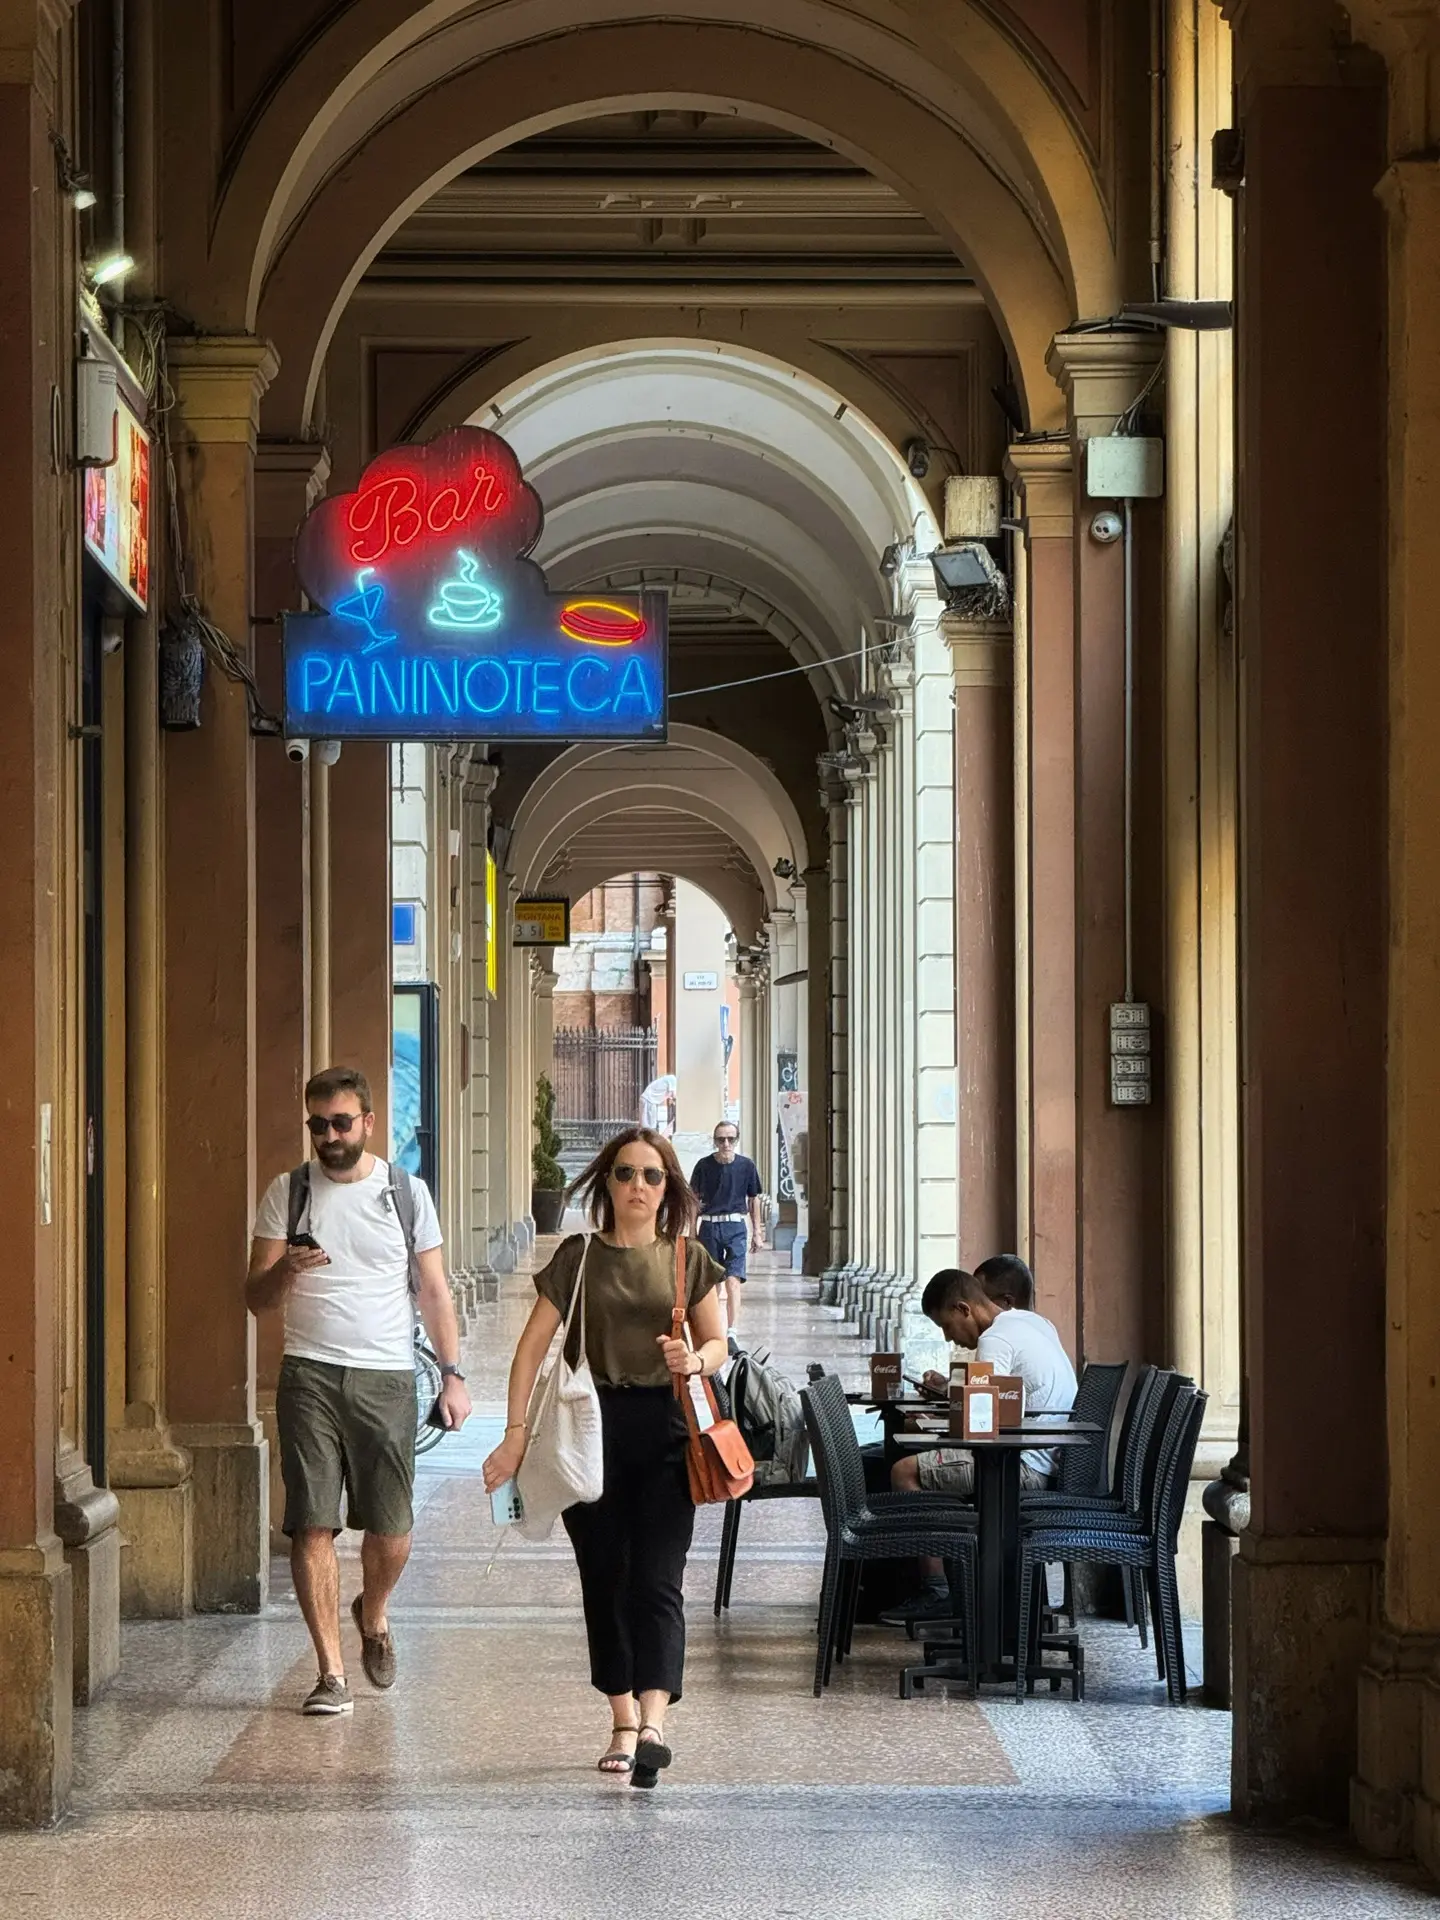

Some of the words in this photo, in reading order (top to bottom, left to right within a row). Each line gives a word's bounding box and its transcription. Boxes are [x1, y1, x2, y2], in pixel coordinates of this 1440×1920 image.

[348, 466, 504, 563] Bar
[302, 655, 654, 714] PANINOTECA
[873, 1365, 897, 1374] Coca-Cola
